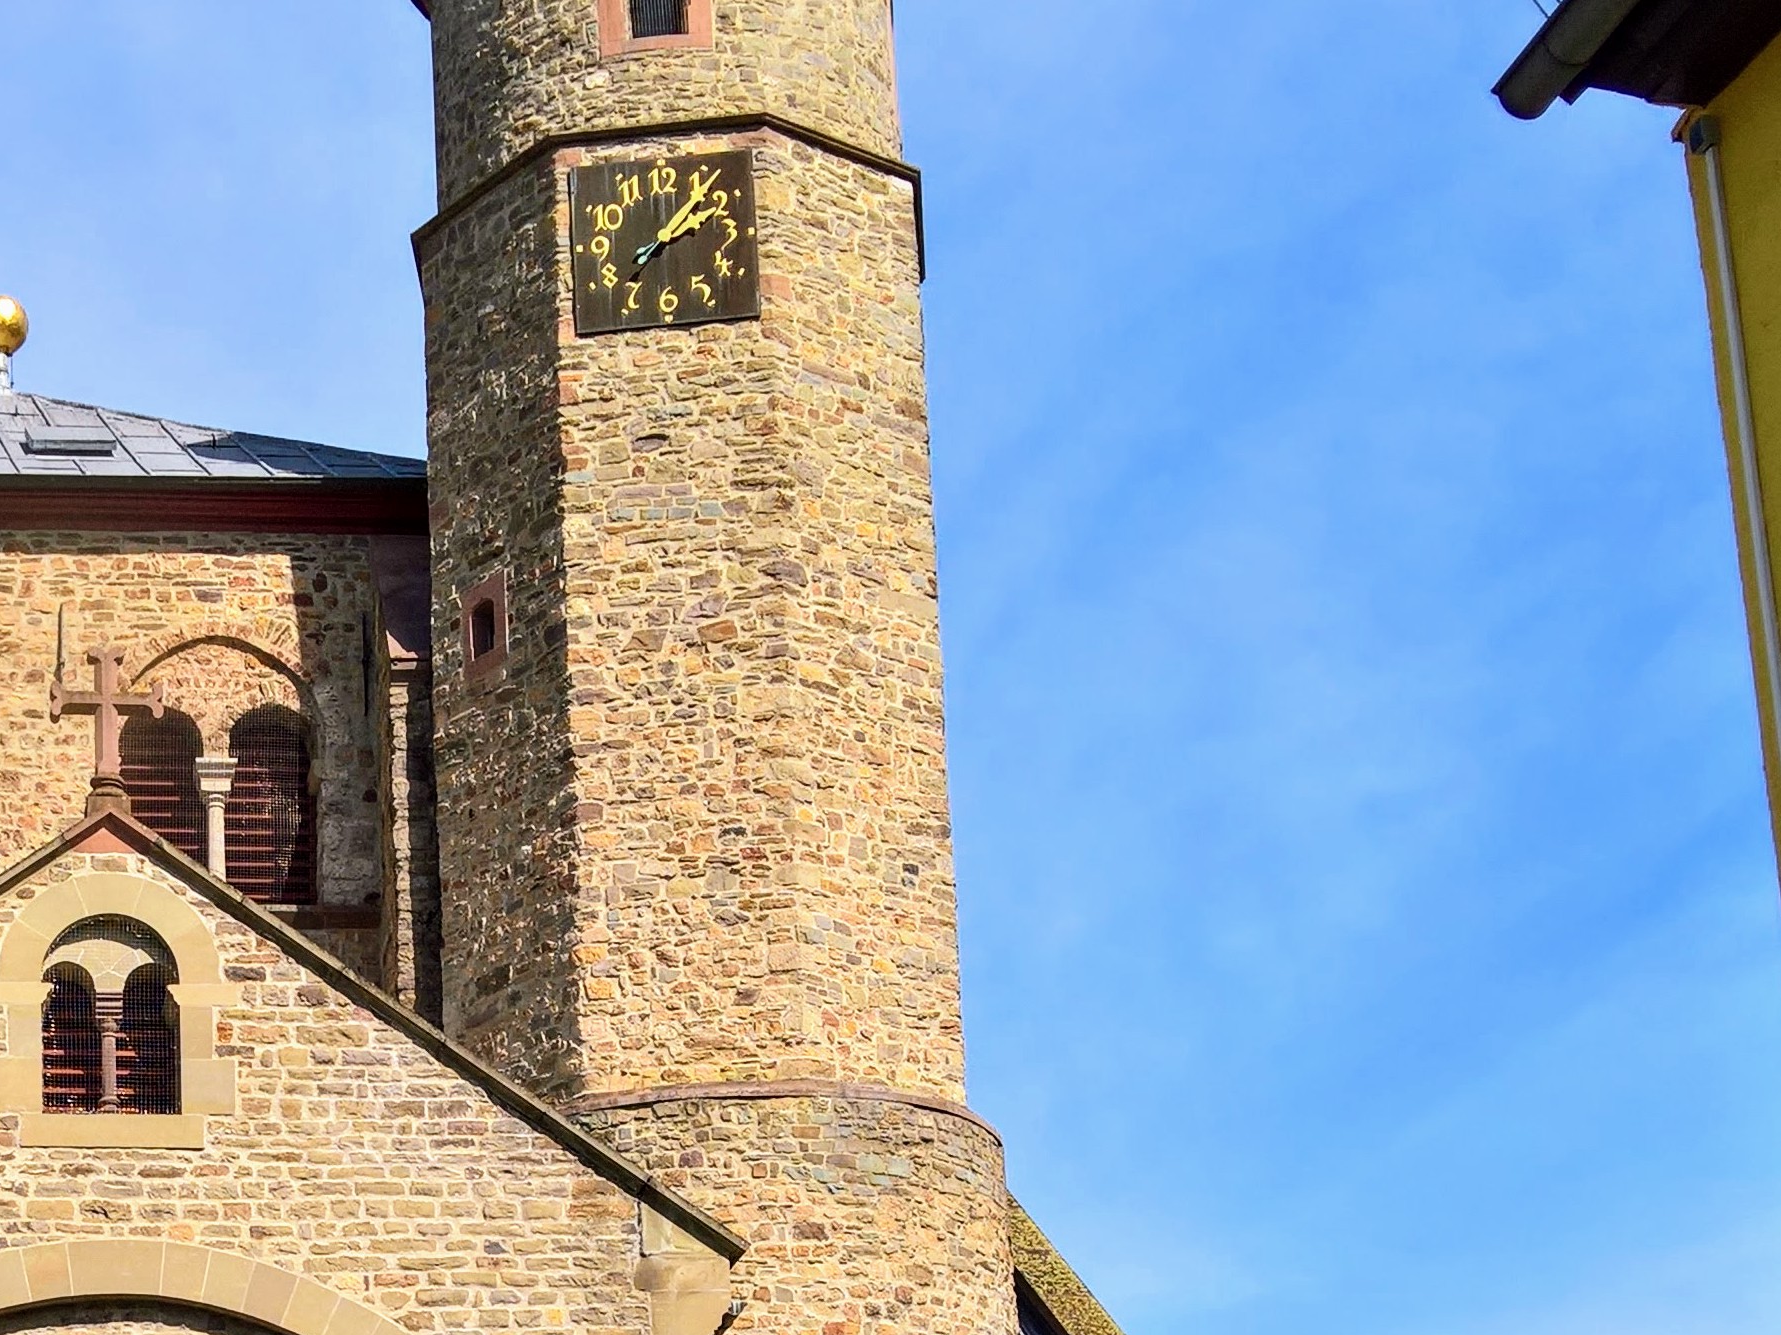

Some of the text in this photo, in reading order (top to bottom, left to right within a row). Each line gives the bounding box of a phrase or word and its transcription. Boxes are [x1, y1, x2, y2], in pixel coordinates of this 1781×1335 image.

[618, 174, 643, 209] 11
[648, 167, 677, 196] 12
[689, 171, 705, 201] 1
[593, 203, 624, 232] 10
[712, 190, 730, 217] 2
[721, 218, 738, 250] 3
[591, 235, 610, 262] 9
[601, 262, 619, 289] 8
[714, 250, 733, 276] 4
[625, 281, 642, 309] 7
[659, 285, 678, 313] 6
[691, 274, 711, 303] 5
